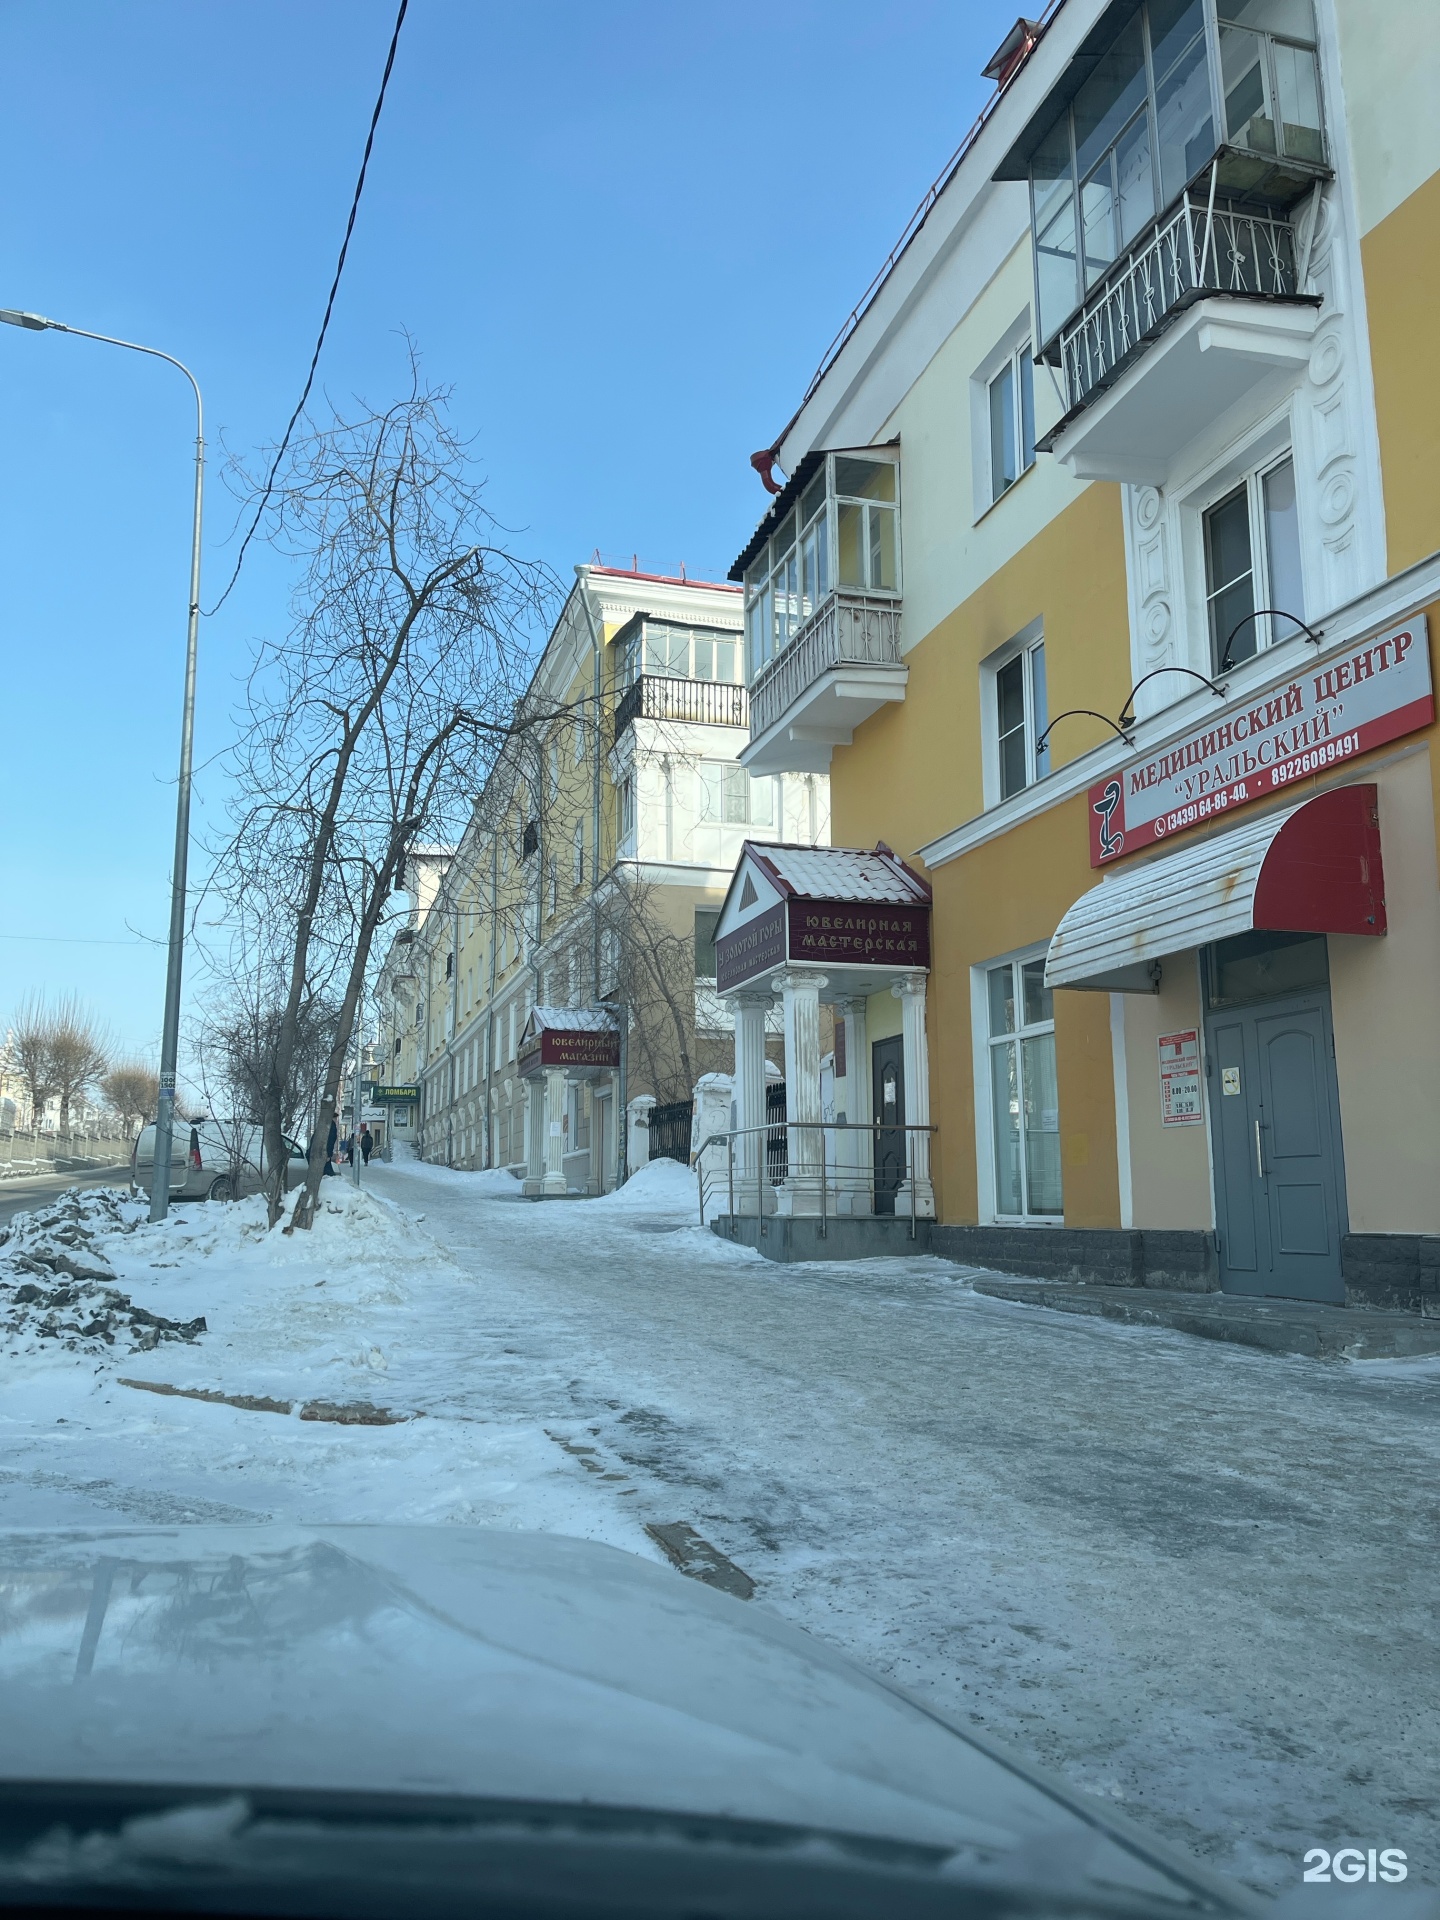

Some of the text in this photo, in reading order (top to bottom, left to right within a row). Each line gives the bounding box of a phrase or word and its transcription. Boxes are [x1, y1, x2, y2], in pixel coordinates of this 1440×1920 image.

[1130, 631, 1413, 795] МЕДИЦИНСКИЙ ЦЕНТР
[1167, 804, 1198, 831] (3439)
[1271, 732, 1360, 786] 89226089491
[725, 927, 758, 963] ЗОЛОТОЙ
[760, 917, 783, 943] ГОРЫ
[806, 915, 912, 935] ЮВЕЛИРНАЯ
[802, 934, 918, 953] МАСТЕРСКАЯ
[385, 1088, 417, 1097] ЛОМБАРД
